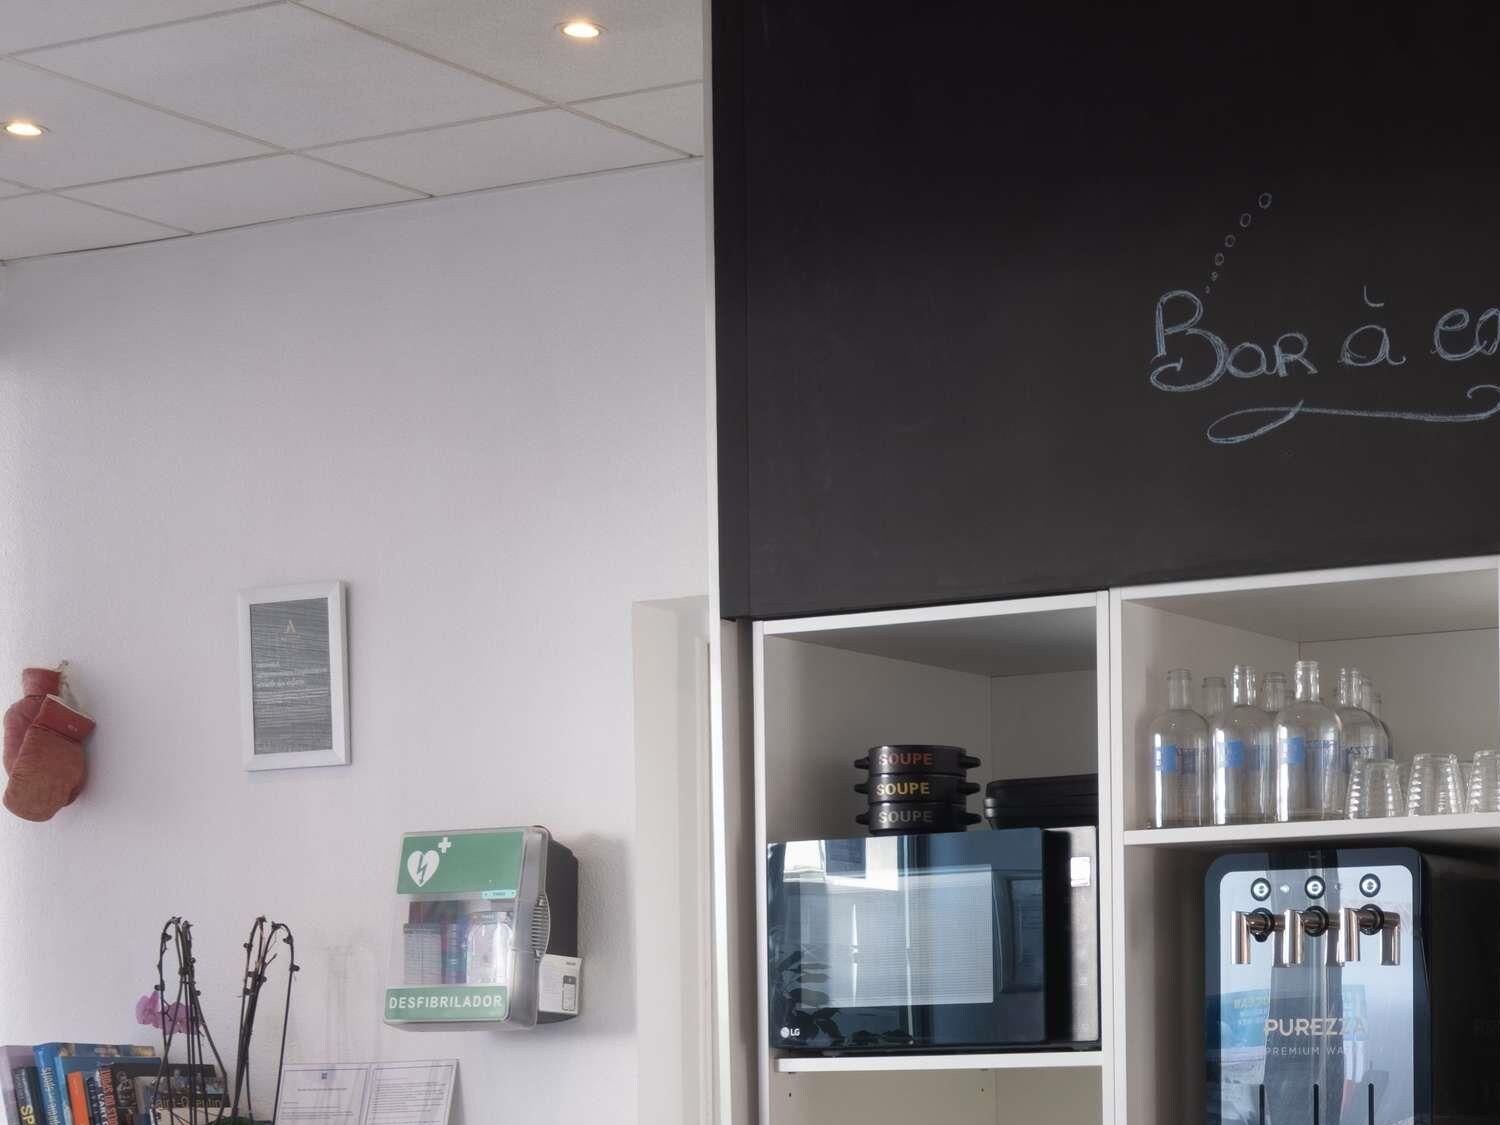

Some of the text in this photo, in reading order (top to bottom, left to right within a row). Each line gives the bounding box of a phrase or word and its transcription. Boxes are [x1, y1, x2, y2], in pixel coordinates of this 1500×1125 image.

[1338, 286, 1406, 366] à
[879, 752, 934, 766] SOUPE
[876, 782, 931, 796] SOUPE
[879, 810, 933, 824] SOUPE
[389, 995, 503, 1009] DESFIBRILADOR
[1265, 1047, 1320, 1056] PREMIUM
